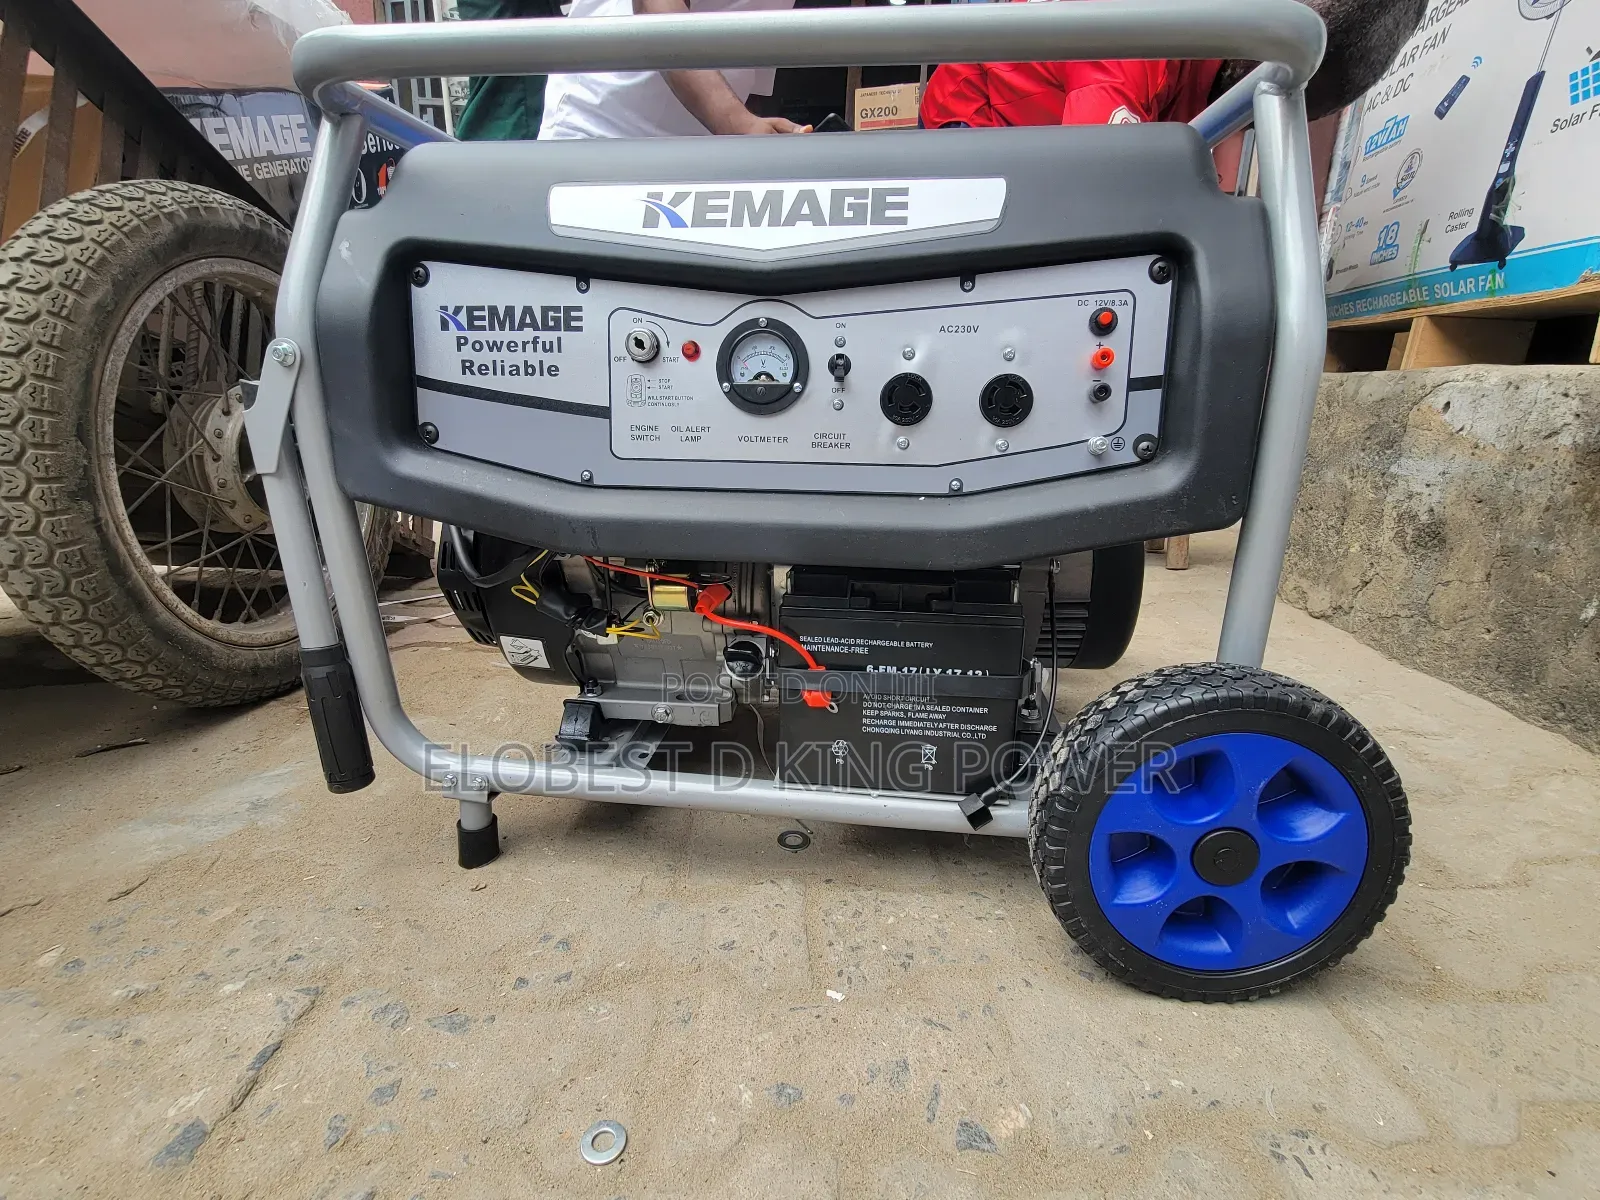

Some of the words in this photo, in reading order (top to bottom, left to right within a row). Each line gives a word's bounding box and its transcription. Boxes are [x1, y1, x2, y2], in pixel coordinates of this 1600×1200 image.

[1375, 44, 1419, 86] OLAR
[1419, 23, 1452, 59] FAN
[860, 106, 898, 118] GX200
[1550, 111, 1587, 133] Solar
[638, 186, 910, 228] KEMAGE
[1448, 206, 1474, 222] Rolling
[1445, 220, 1469, 233] Caster
[1378, 221, 1400, 248] 18
[1356, 286, 1429, 313] RECHARGEABLE
[1434, 278, 1475, 298] SOLAR
[1478, 272, 1505, 292] FAN
[435, 305, 584, 332] KEMAGE
[939, 325, 980, 334] AC230V
[456, 336, 562, 354] Powerful
[461, 359, 560, 377] Reliable
[738, 435, 789, 444] VOLTMETER
[801, 644, 869, 654] MAINTENANCE-FREE
[857, 639, 905, 648] RECHARGEABLE
[880, 710, 906, 718] SPARKS,
[862, 718, 896, 726] RECHARGE
[960, 723, 998, 731] DISCHARGE
[862, 726, 900, 735] CHONGQING
[924, 730, 960, 738] INDUSTRIAL
